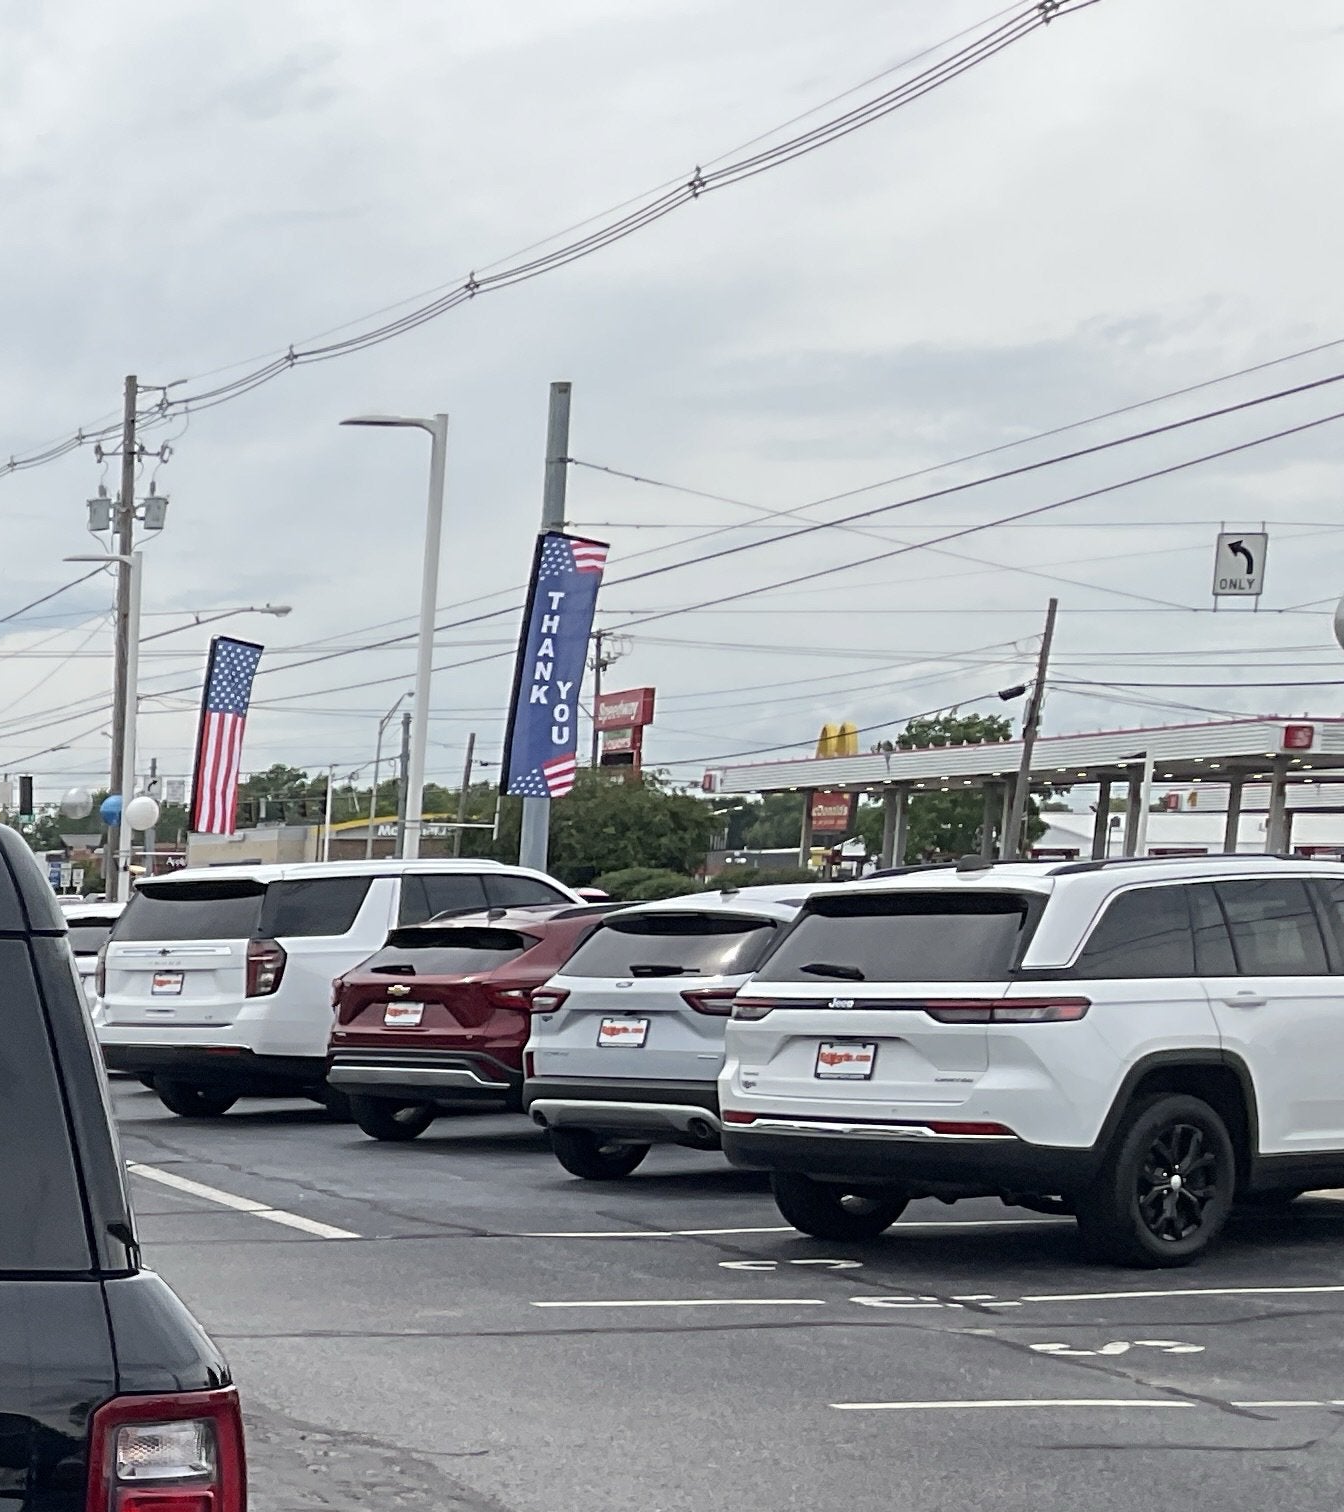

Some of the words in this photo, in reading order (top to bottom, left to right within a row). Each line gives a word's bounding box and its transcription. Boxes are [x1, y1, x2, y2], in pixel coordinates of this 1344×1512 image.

[1219, 578, 1256, 590] ONLY
[529, 591, 565, 705] THANK
[551, 680, 573, 745] YOU
